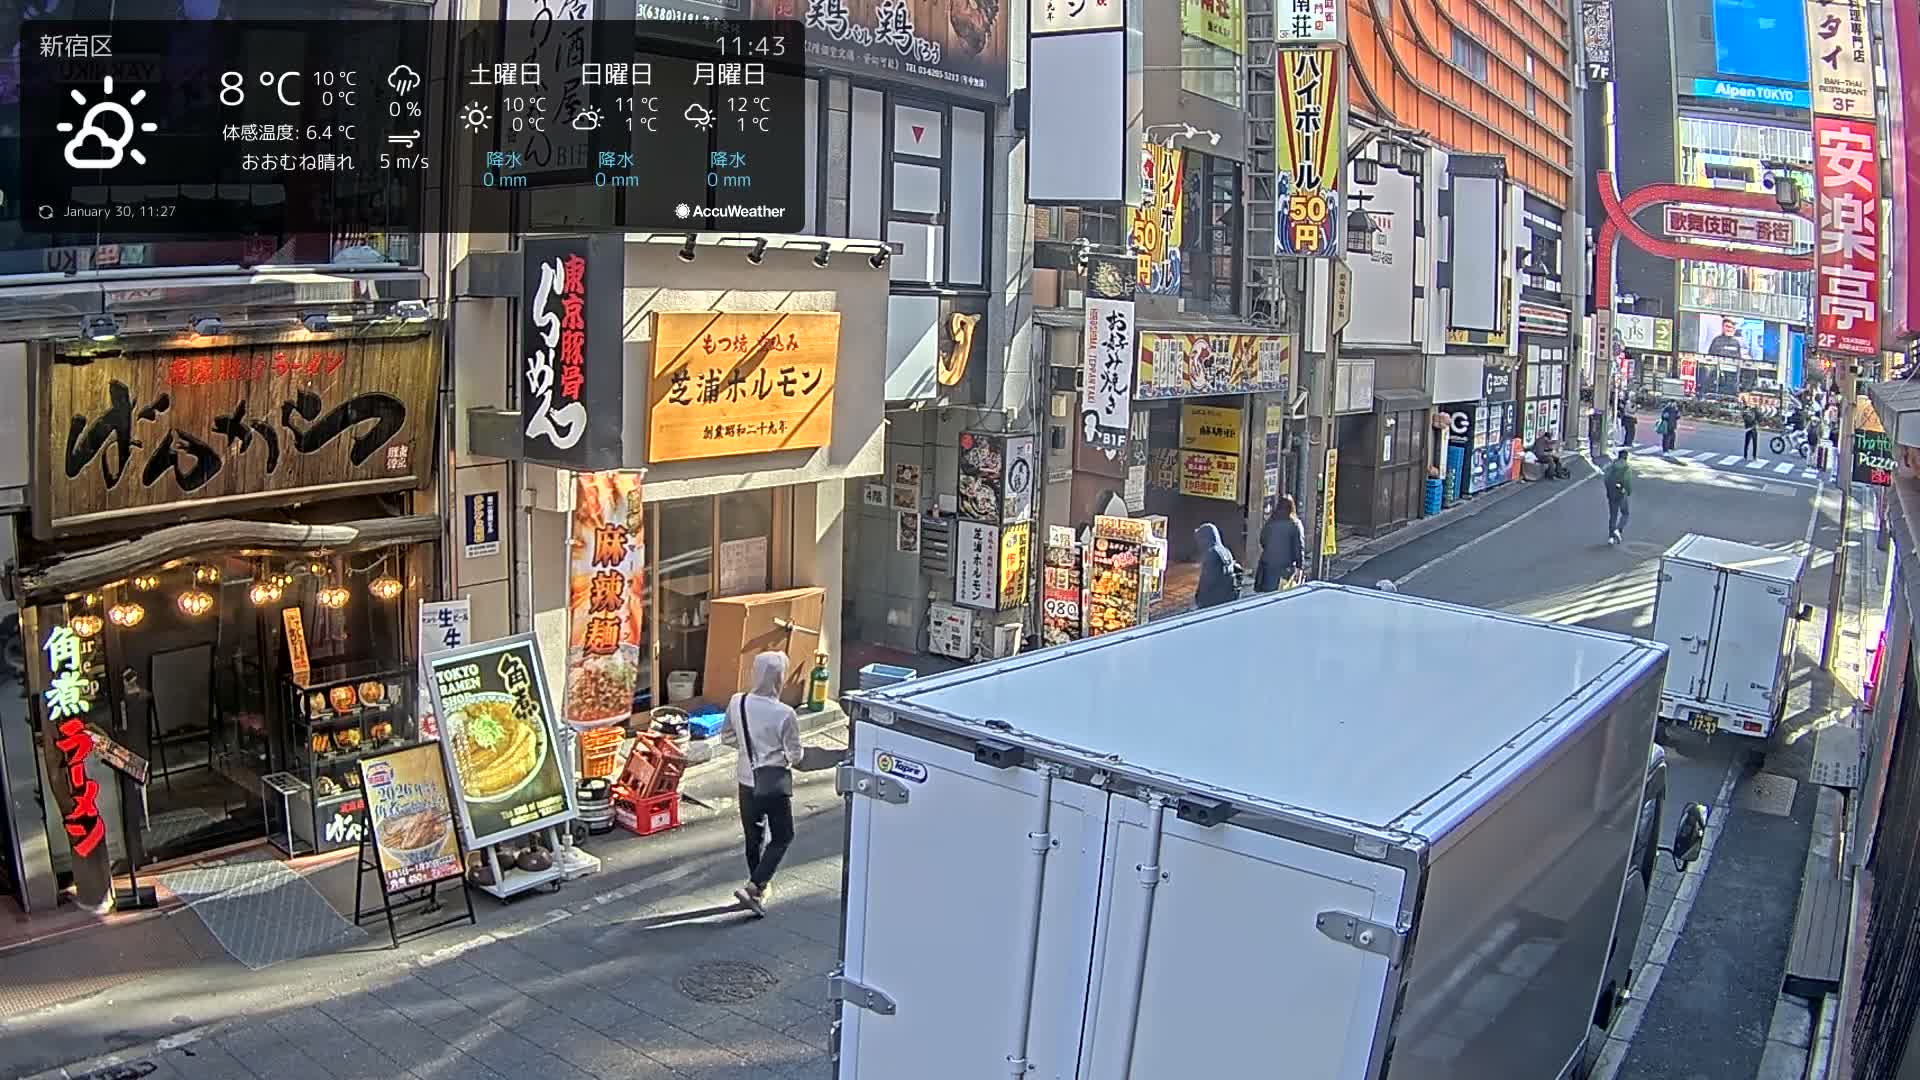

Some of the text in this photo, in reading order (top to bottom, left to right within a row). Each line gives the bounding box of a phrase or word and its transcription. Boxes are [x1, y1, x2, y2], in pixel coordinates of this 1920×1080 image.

[1589, 64, 1609, 79] 7F
[1715, 83, 1793, 102] Alpen TOKYO
[1819, 85, 1867, 96] RESTAURANT
[1833, 98, 1855, 112] 3F
[1294, 54, 1321, 191] ハイボール
[1670, 211, 1790, 243] 歌舞伎町一番街
[1819, 127, 1876, 330] 安楽亭
[561, 253, 585, 400] 東京豚骨
[1819, 333, 1836, 347] 2F
[1101, 310, 1128, 415] お好み焼き
[668, 366, 823, 406] 芝浦ホルモン
[1102, 432, 1126, 446] B1F
[583, 523, 628, 656] 麻辣麺
[43, 626, 90, 722] 角煮
[436, 664, 480, 683] TOKYO
[440, 677, 481, 696] RAMEN
[499, 654, 539, 721] 角煮
[55, 717, 105, 857] ラーメン
